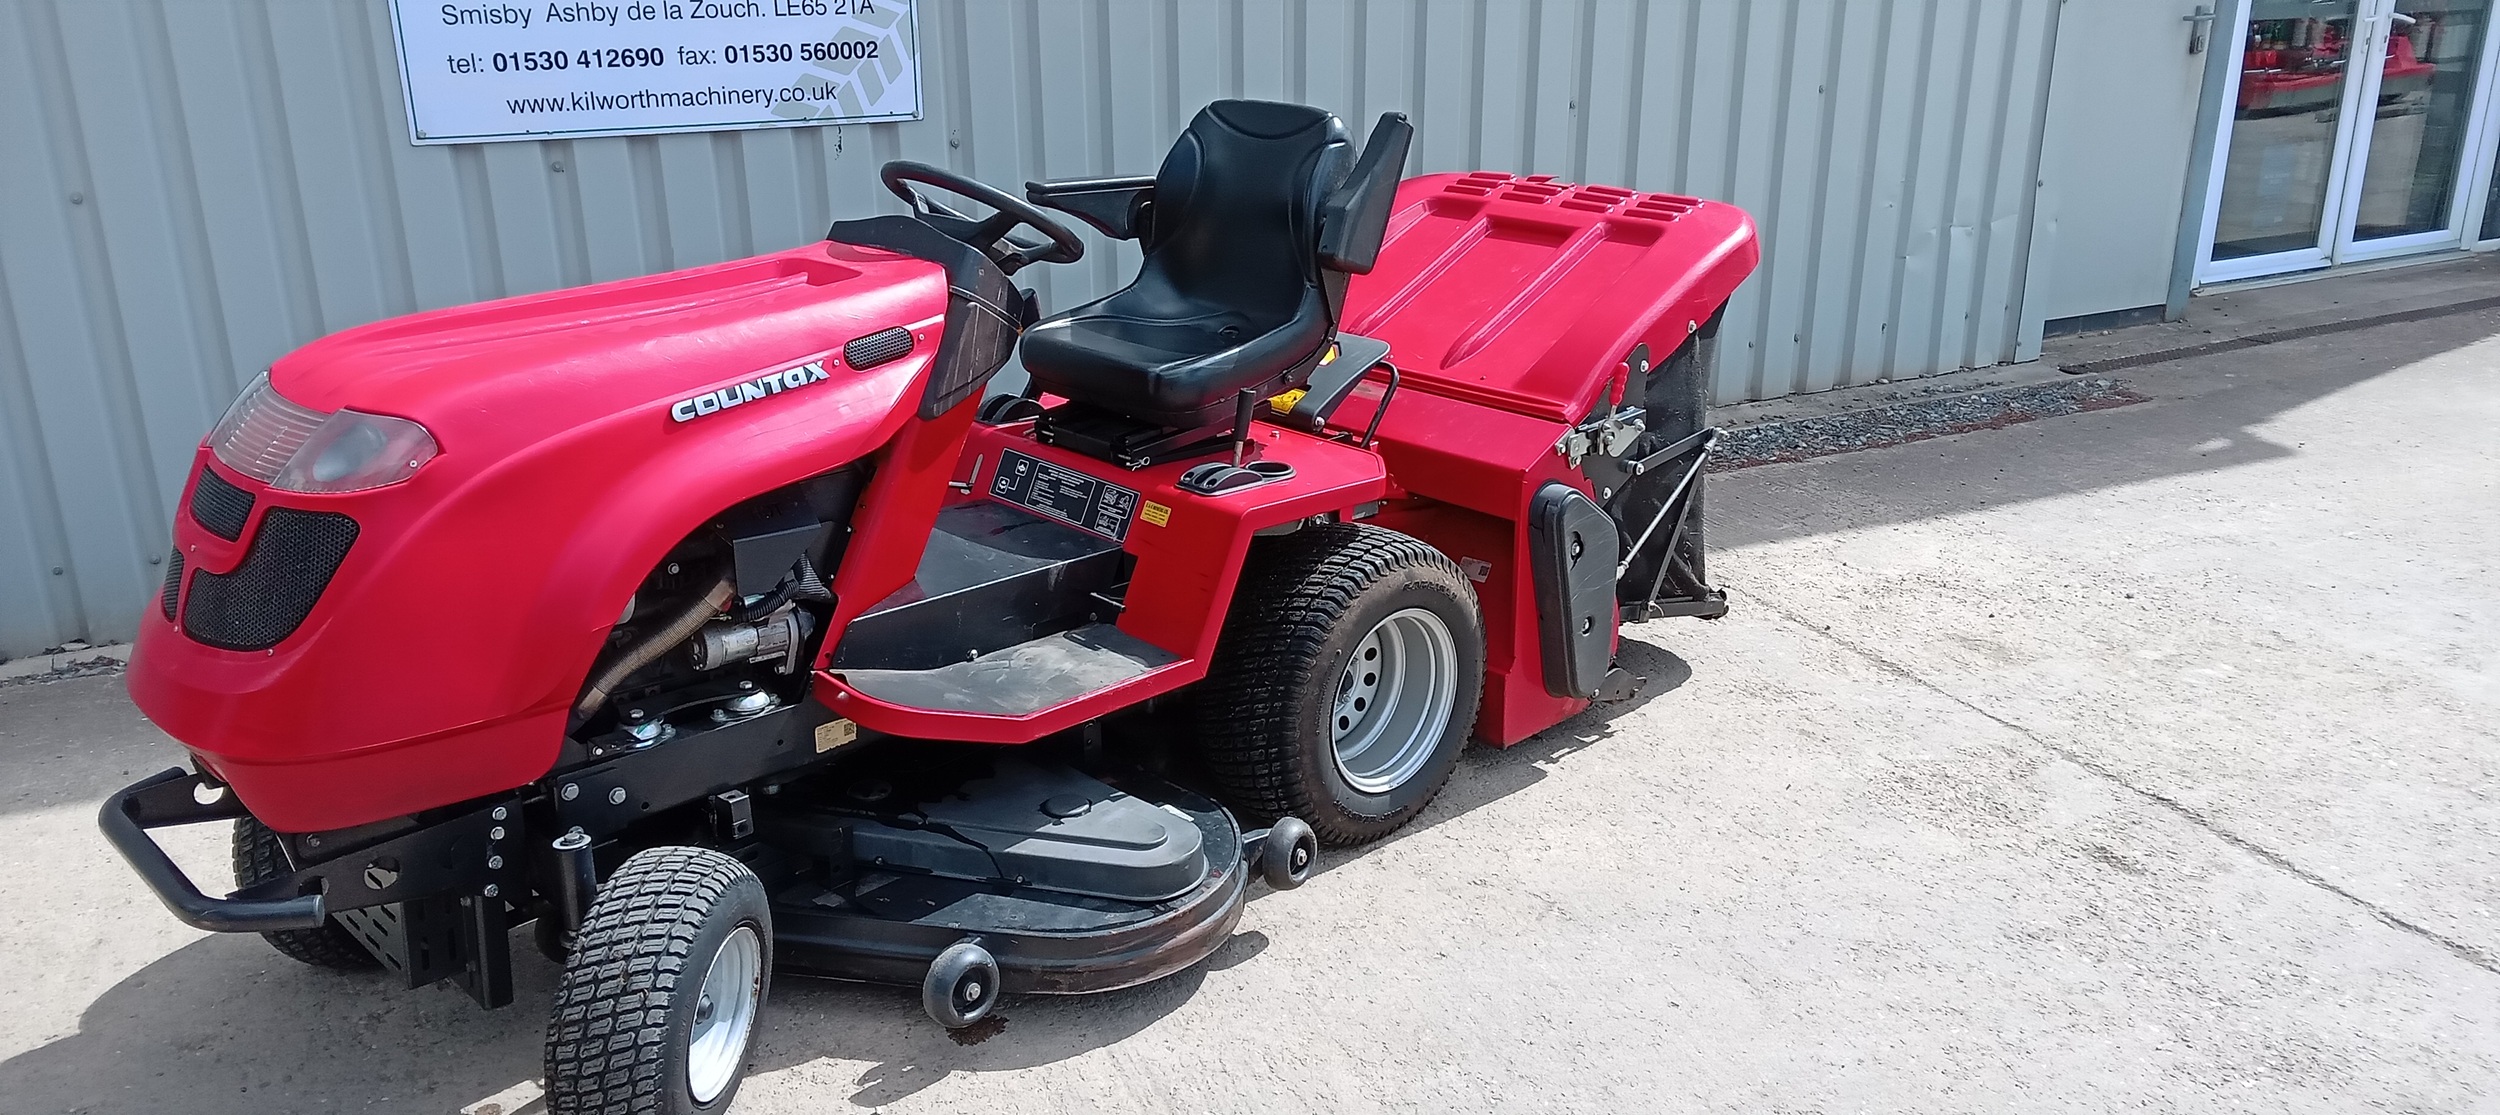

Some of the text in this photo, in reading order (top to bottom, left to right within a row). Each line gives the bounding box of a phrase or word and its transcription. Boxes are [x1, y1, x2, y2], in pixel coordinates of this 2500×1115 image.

[441, 4, 531, 29] Smisby
[546, 2, 619, 26] Ashby
[627, 0, 656, 21] de
[662, 0, 683, 20] la
[689, 0, 766, 19] Zouch.
[774, 0, 827, 17] LE65
[446, 41, 879, 74] tel: 01530 412690 fax: 01530 560002
[506, 82, 837, 114] www.kilworthmachinery.co.uk
